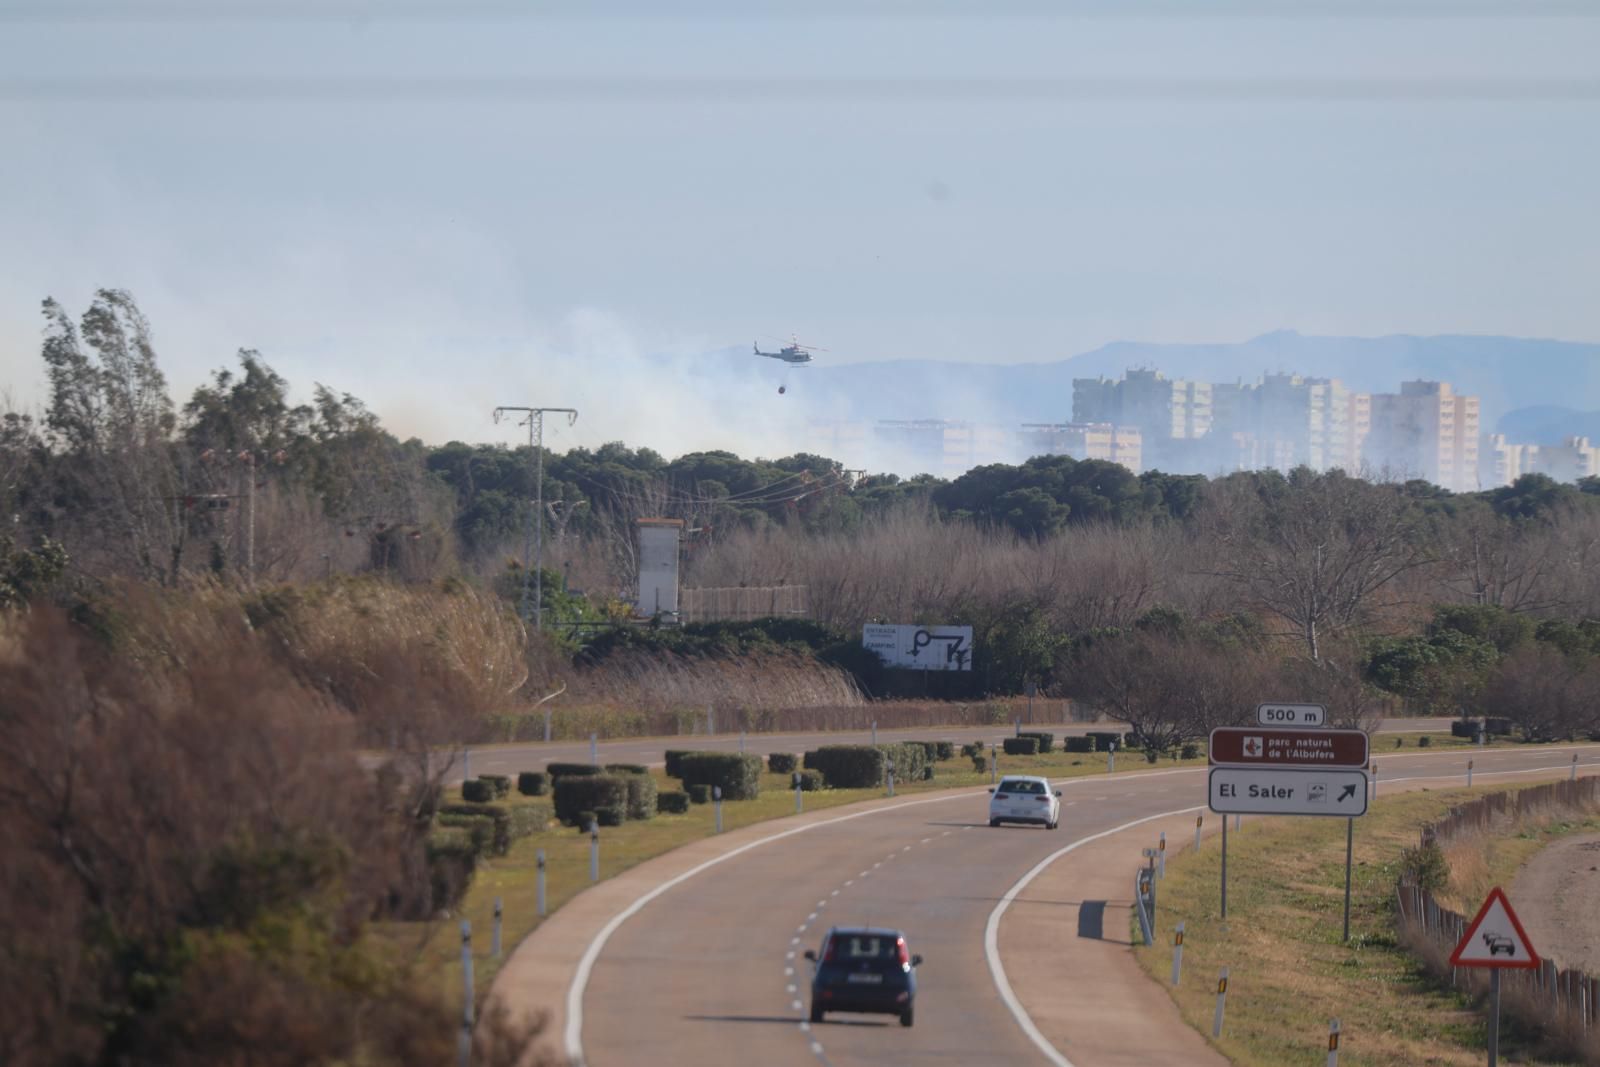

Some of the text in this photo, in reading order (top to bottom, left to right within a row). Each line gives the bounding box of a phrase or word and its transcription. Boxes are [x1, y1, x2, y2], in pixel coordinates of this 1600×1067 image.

[1266, 709, 1317, 722] 500 m
[1268, 738, 1332, 747] parc natural
[1268, 749, 1335, 759] de l'Albufera
[1219, 783, 1294, 799] El Saler
